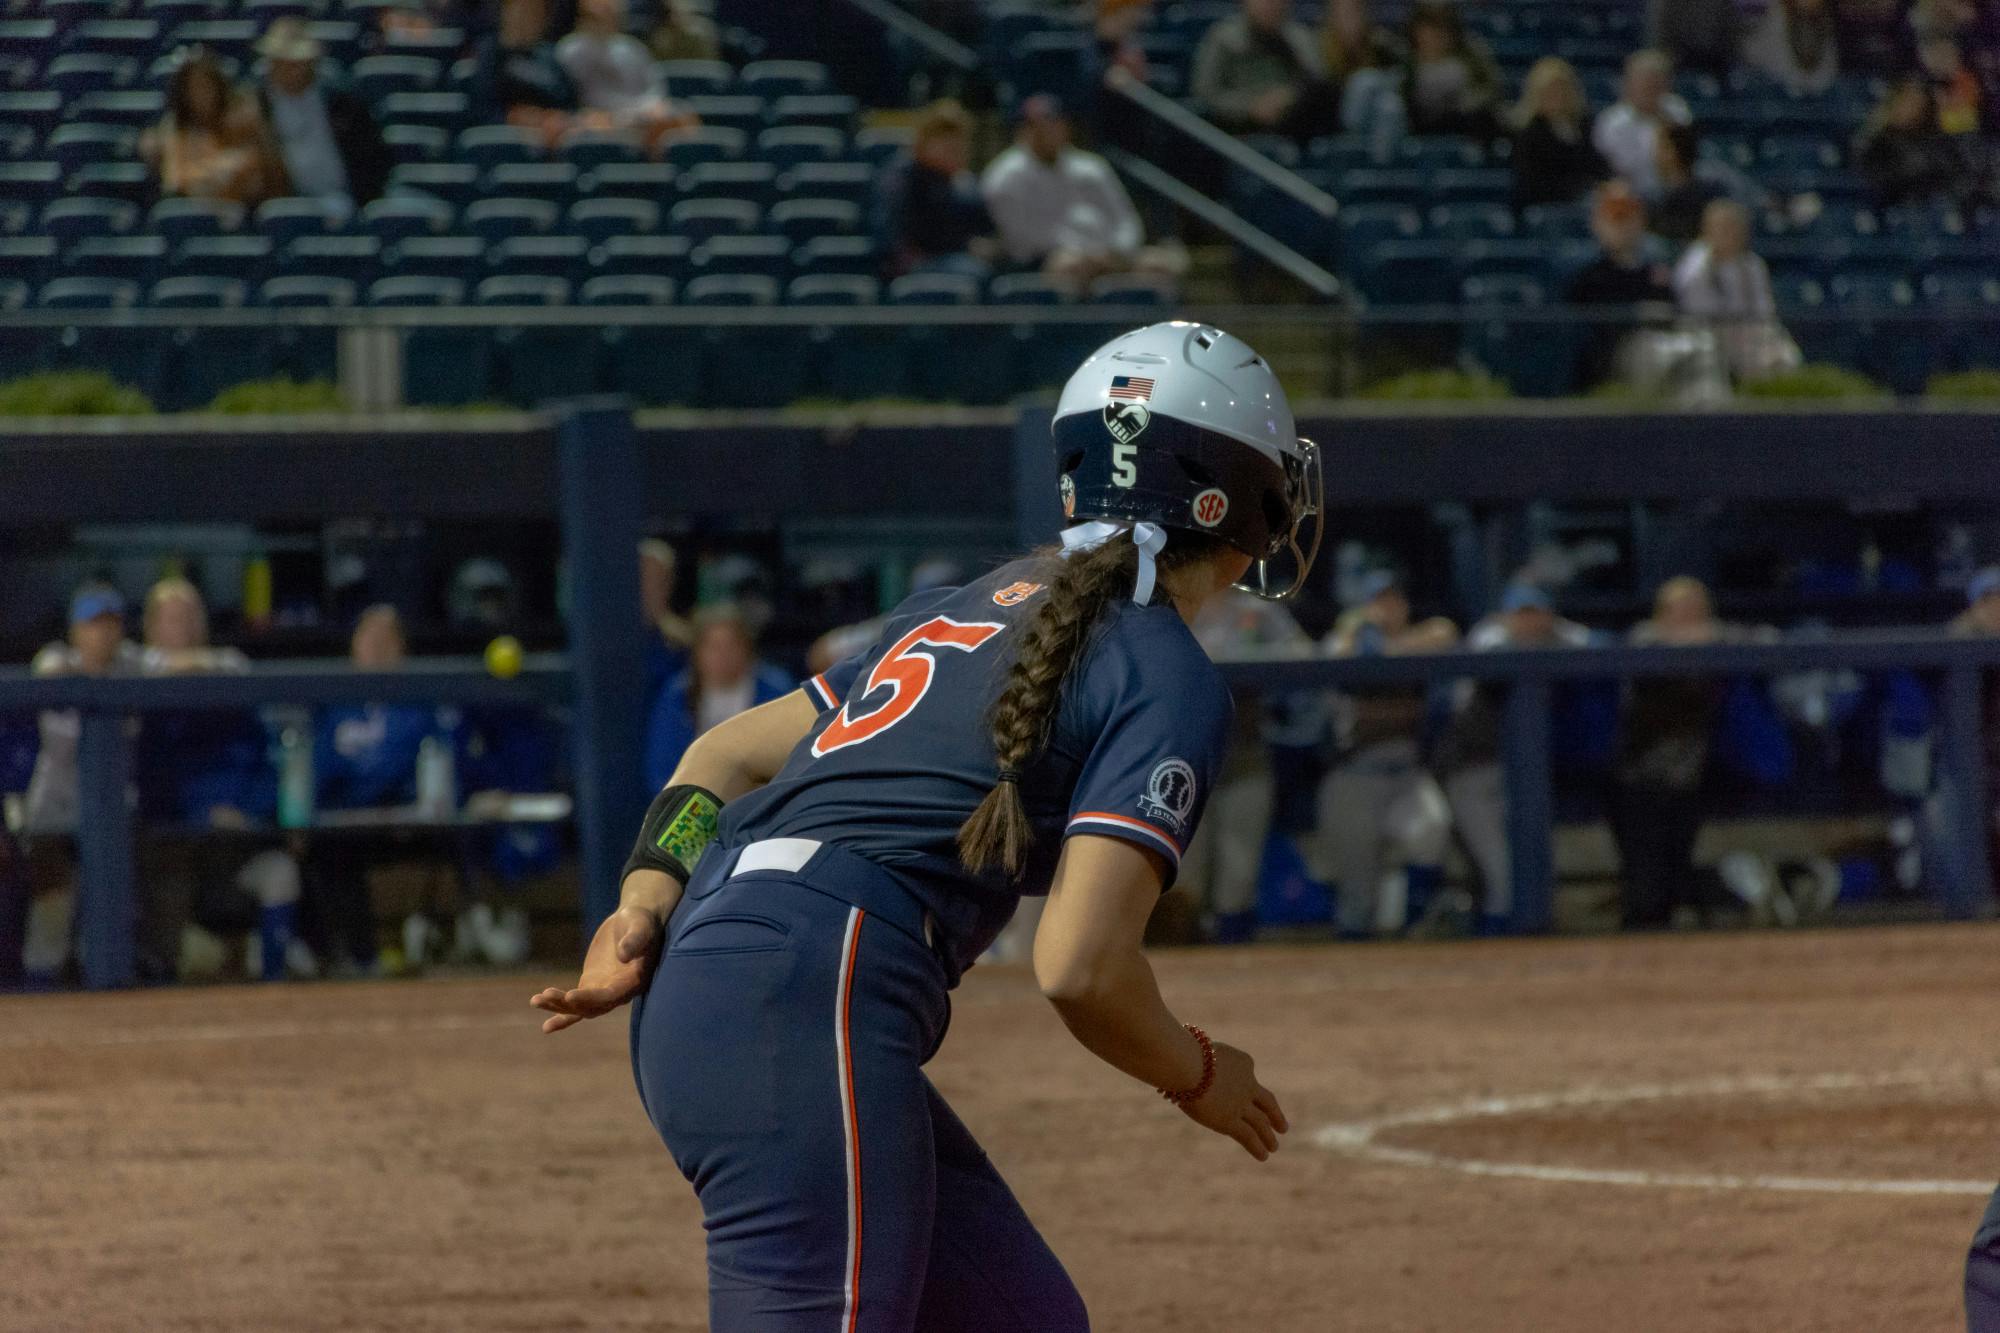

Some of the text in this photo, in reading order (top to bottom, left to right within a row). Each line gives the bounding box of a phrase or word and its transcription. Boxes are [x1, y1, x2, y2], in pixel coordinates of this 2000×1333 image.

[1112, 443, 1137, 488] 5
[1198, 494, 1225, 523] SEC
[811, 614, 1007, 759] 5
